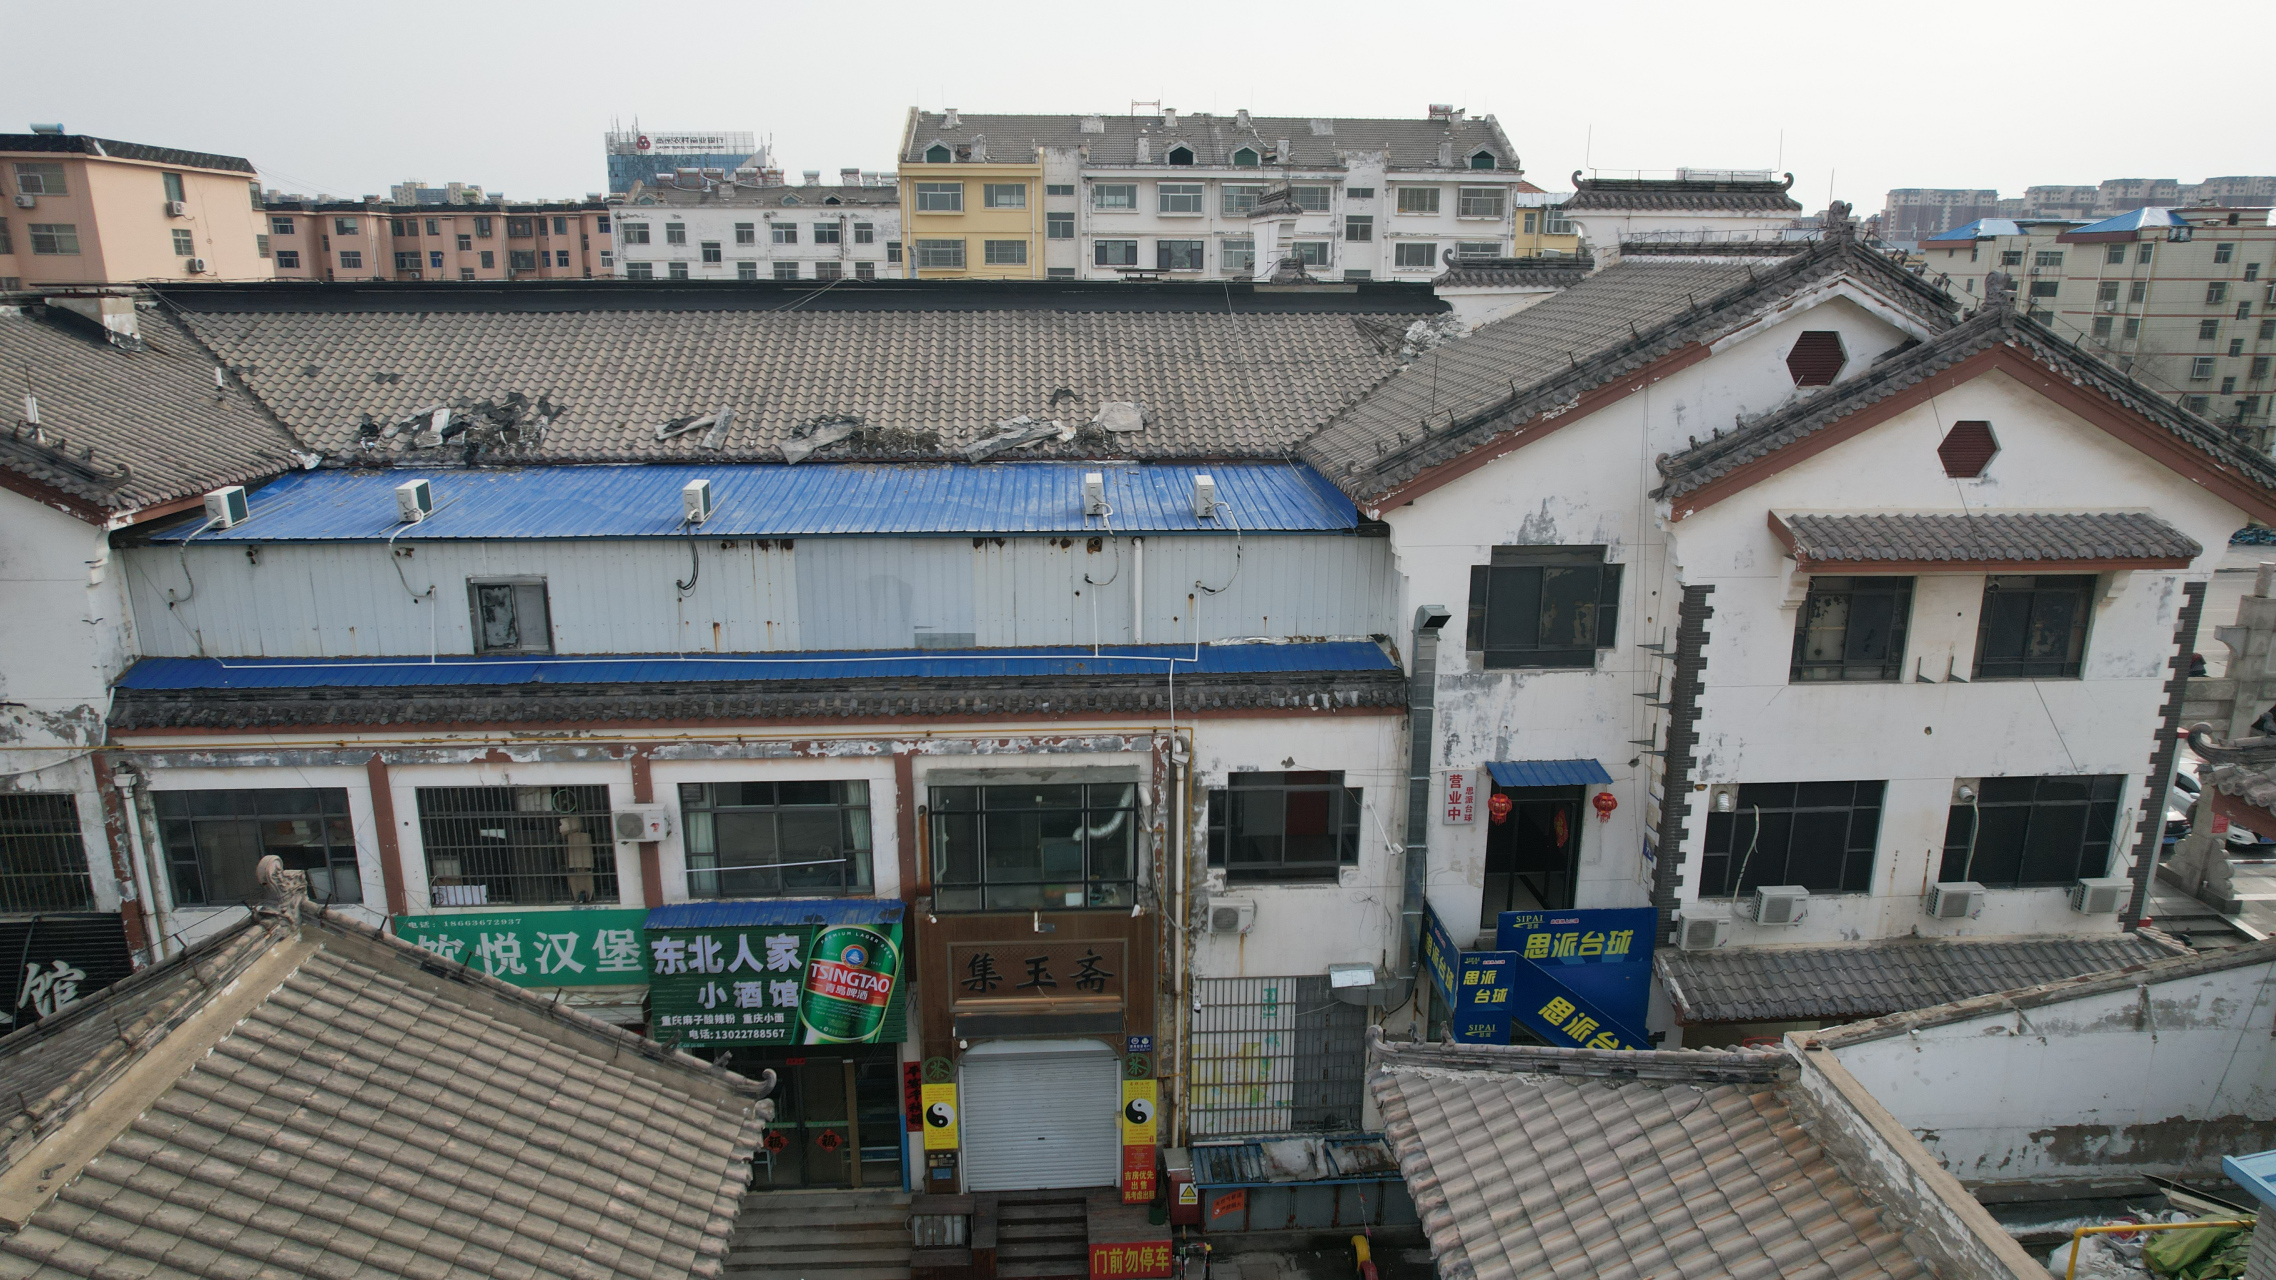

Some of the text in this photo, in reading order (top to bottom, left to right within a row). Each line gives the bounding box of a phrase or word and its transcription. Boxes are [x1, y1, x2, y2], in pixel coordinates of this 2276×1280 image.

[1447, 774, 1463, 821] 营业中
[1464, 786, 1474, 822] 思派台球
[443, 918, 523, 928] 18663672937
[1515, 914, 1544, 923] SIPAI
[821, 931, 852, 944] PREMIUM
[855, 931, 879, 944] LAGER
[1524, 929, 1634, 959] 思派台球
[650, 932, 803, 975] 东北人家
[1424, 931, 1455, 994] 思派台球
[811, 962, 890, 993] TSINGTAO
[961, 948, 1115, 993] 集玉斋
[1463, 970, 1497, 986] 思派
[697, 978, 799, 1010] 小酒馆
[825, 982, 868, 1001] 青岛啤酒
[1474, 987, 1508, 1004] 台球
[660, 1013, 785, 1027] 重庆麻子酸辣粉 重庆小面
[1468, 1023, 1496, 1031] SIPAI
[1538, 995, 1635, 1050] 思派台
[928, 1060, 950, 1079] 茶
[1127, 1056, 1148, 1075] 茶
[768, 1135, 783, 1149] 福
[822, 1134, 837, 1147] 福
[1131, 1180, 1147, 1190] 出售
[1124, 1190, 1155, 1200] 再考虑出租
[1094, 1245, 1170, 1275] 门前勿停车
